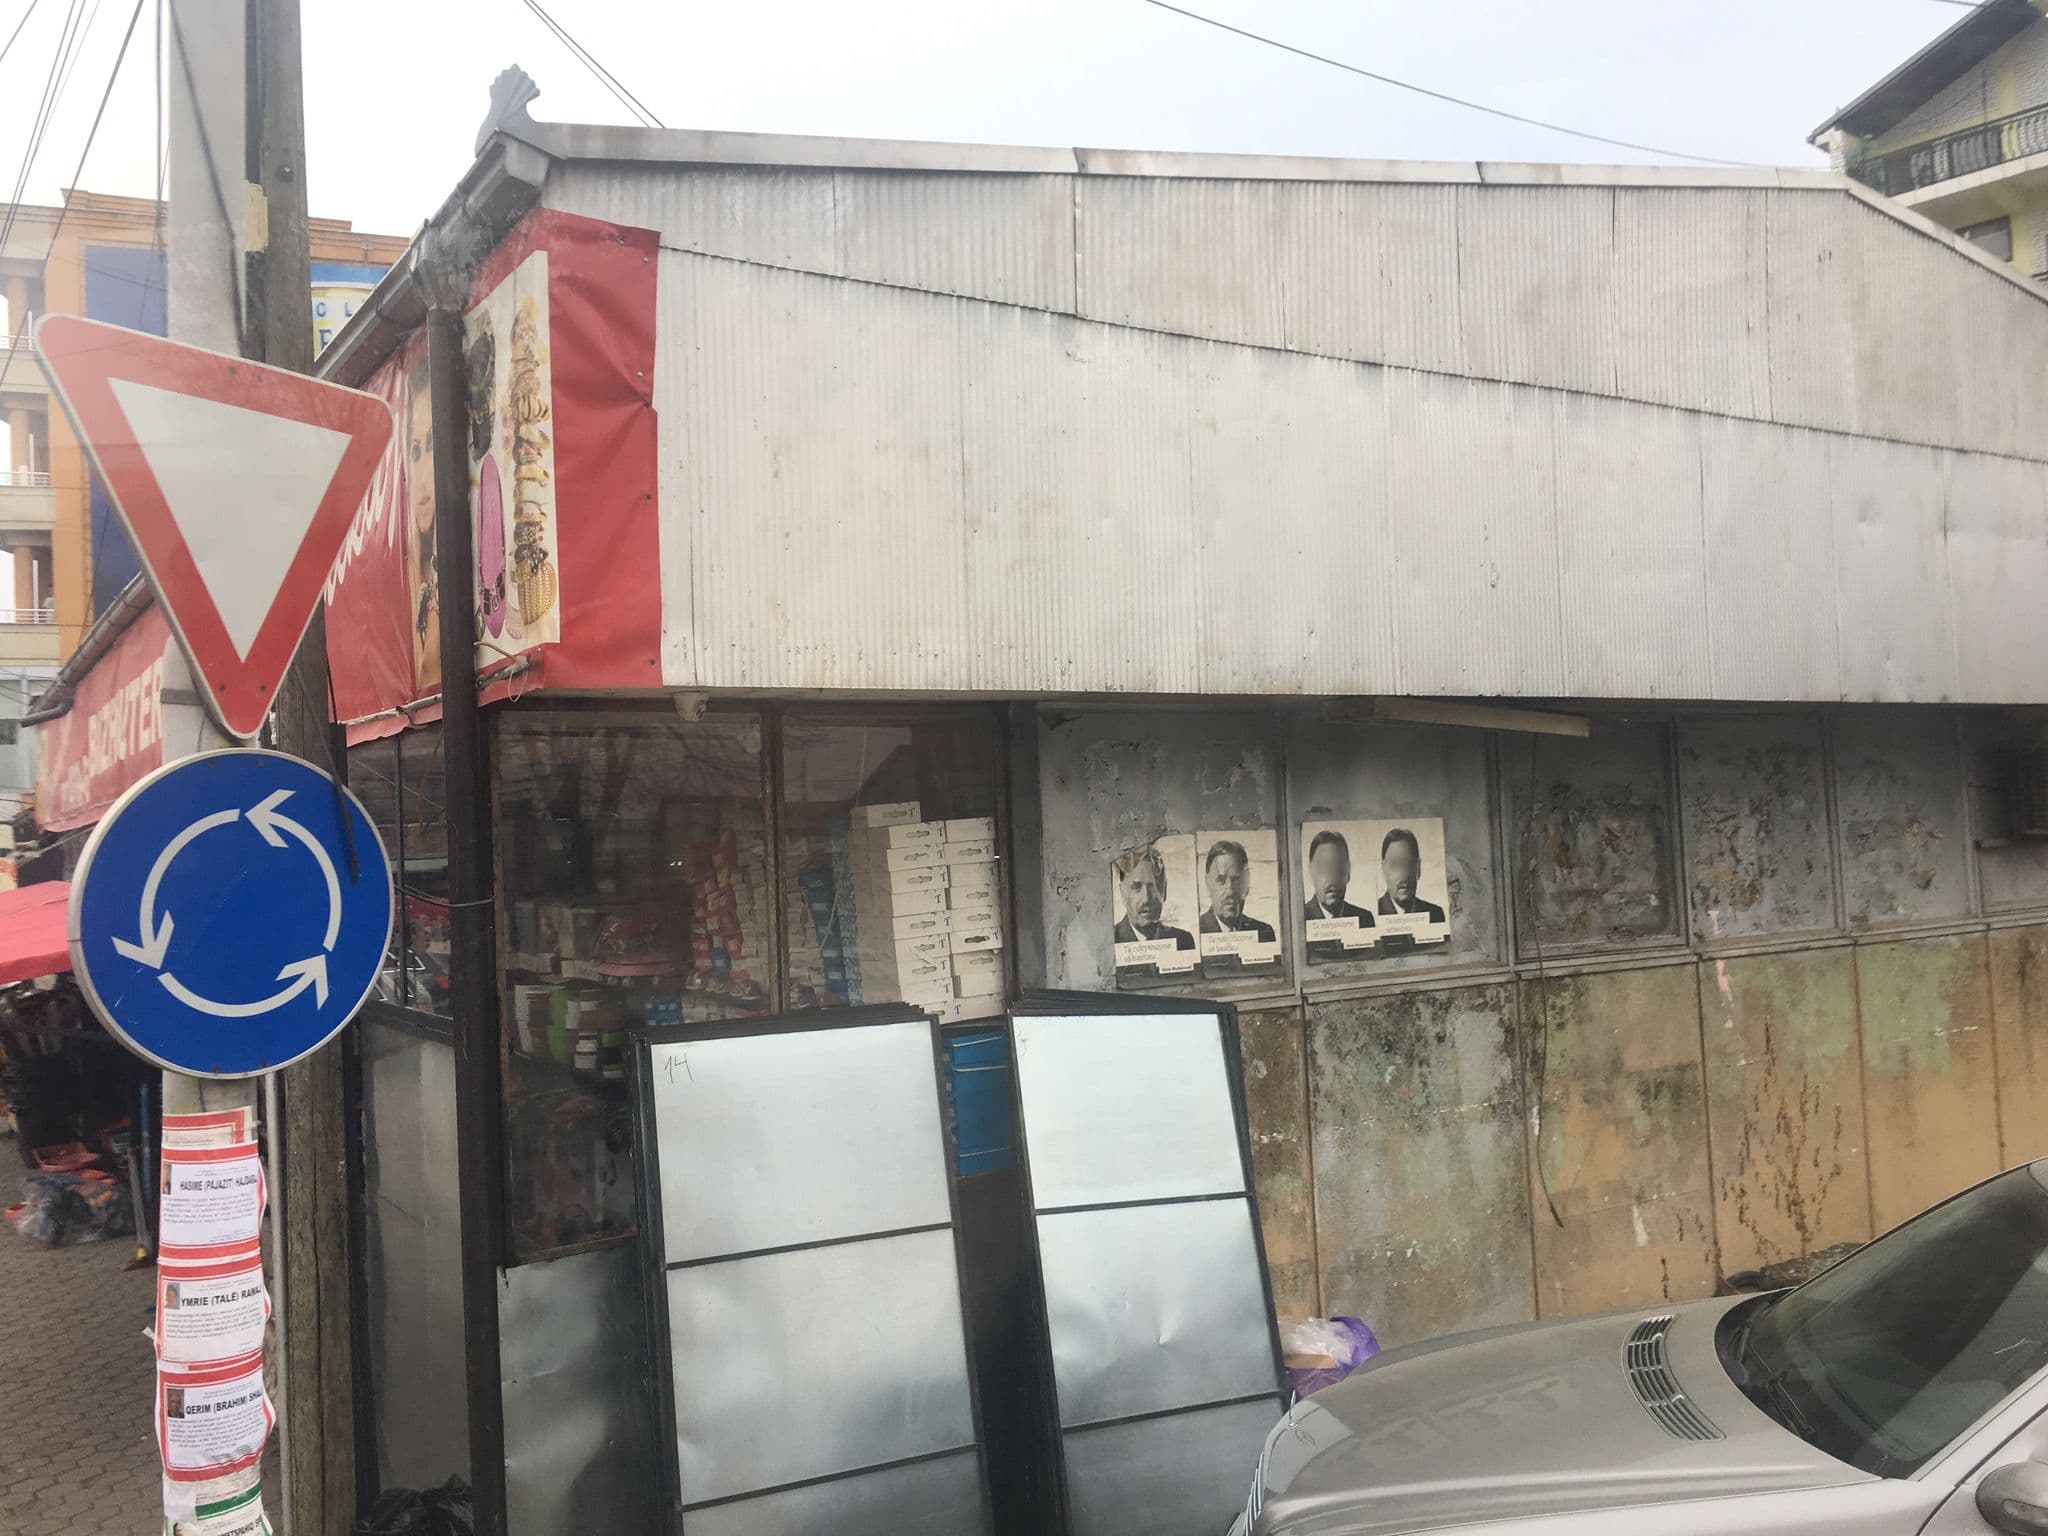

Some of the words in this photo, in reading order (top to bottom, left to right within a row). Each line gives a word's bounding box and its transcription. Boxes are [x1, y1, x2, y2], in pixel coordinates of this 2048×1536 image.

[664, 1051, 695, 1084] 14
[181, 1297, 209, 1307] YMRIE
[185, 1402, 212, 1415] QERIM
